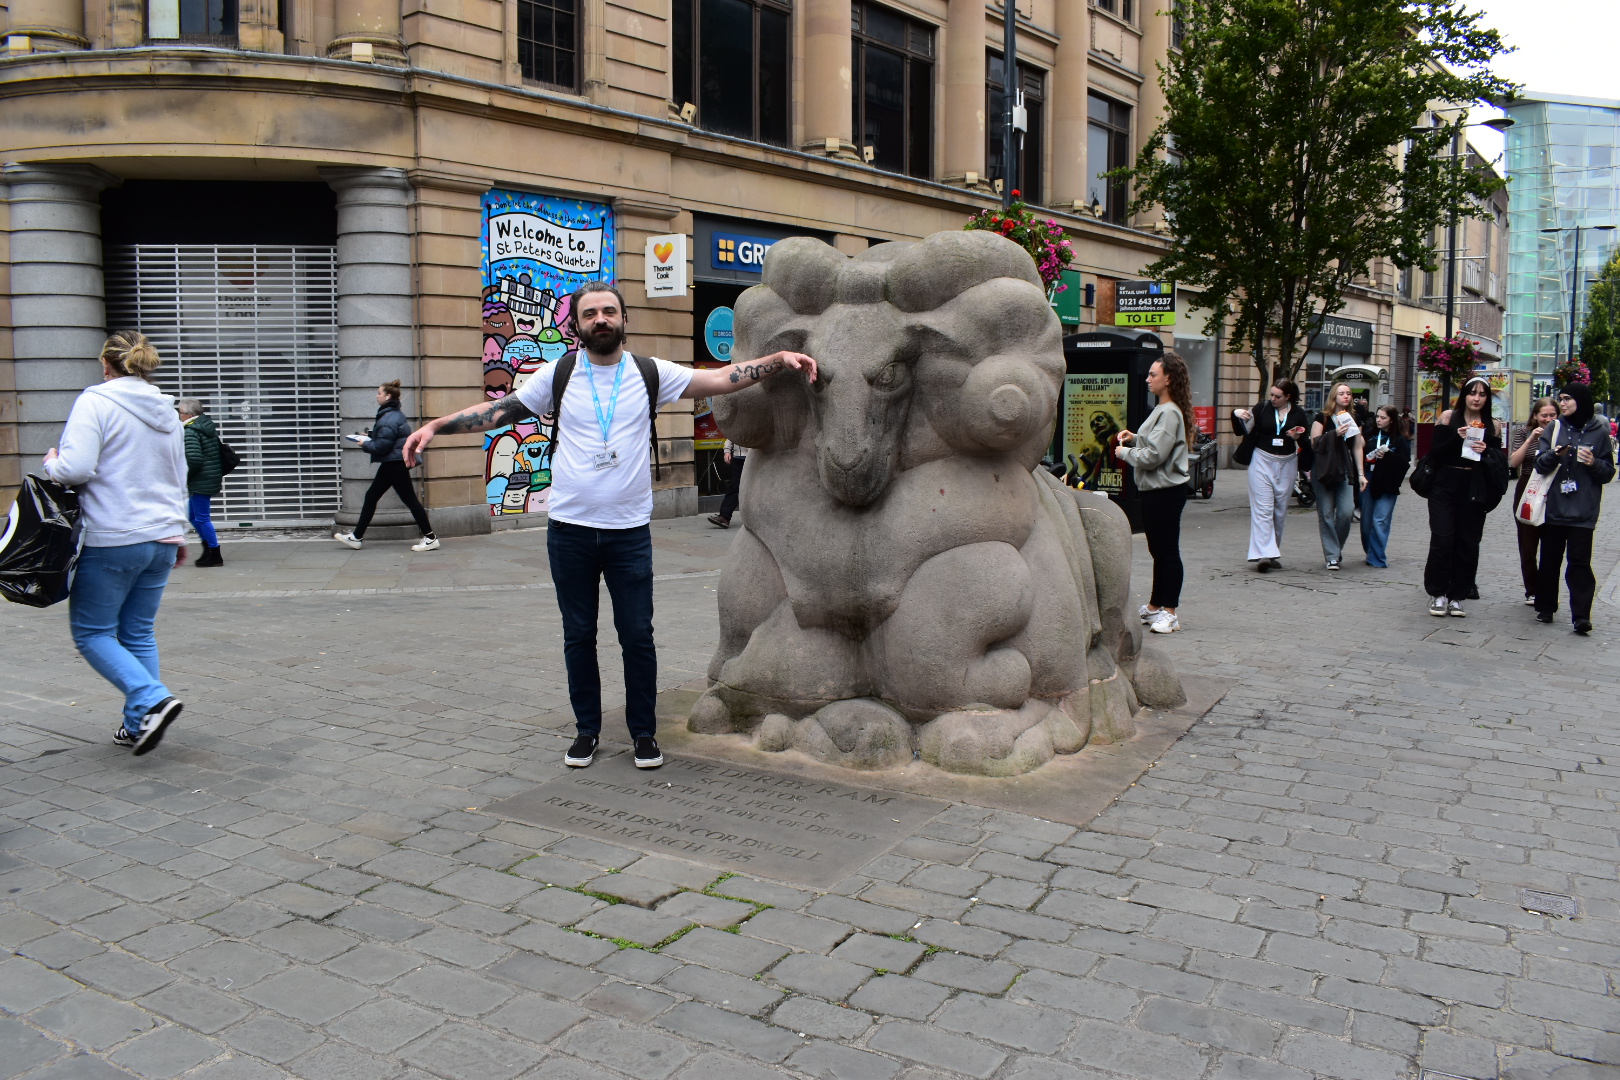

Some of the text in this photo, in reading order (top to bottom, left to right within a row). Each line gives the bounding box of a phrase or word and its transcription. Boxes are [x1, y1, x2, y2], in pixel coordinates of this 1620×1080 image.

[496, 219, 595, 254] Welcome to...
[496, 241, 596, 268] St Peters Quarter
[510, 284, 548, 303] DERBY
[1119, 298, 1137, 306] 0121
[1153, 297, 1172, 305] 9337
[1126, 314, 1165, 323] TO LET
[1320, 321, 1362, 339] AFÉ CENTRAL
[662, 759, 898, 806] THE DERBY RAM
[700, 777, 808, 803] SCULPTOR
[574, 778, 639, 796] GIFTED
[640, 790, 665, 801] TO
[805, 824, 877, 842] DERBY
[683, 812, 707, 822] BY
[745, 799, 831, 821] PEGLER
[543, 796, 823, 863] RICHARDSON CORDWELL
[562, 815, 617, 832] 15TH
[613, 826, 708, 852] MARCH
